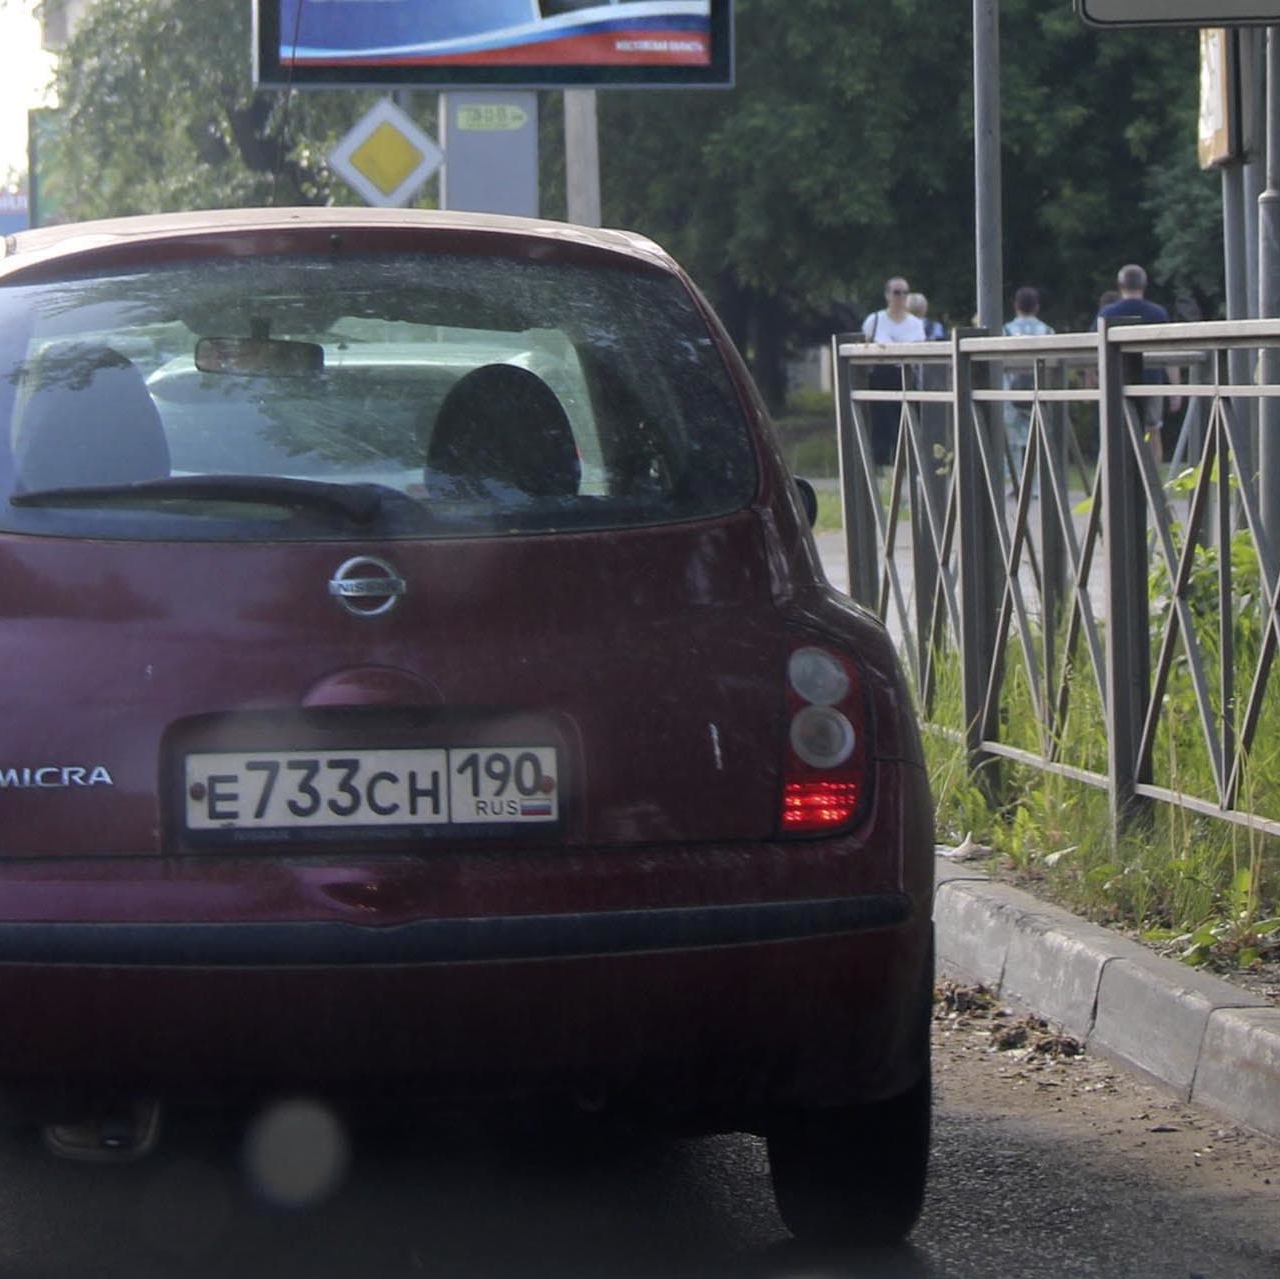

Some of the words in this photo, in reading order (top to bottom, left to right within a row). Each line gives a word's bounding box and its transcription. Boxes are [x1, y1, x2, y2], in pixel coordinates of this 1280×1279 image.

[208, 758, 439, 820] Е733СН
[457, 751, 543, 798] 190
[475, 800, 519, 816] RUS
